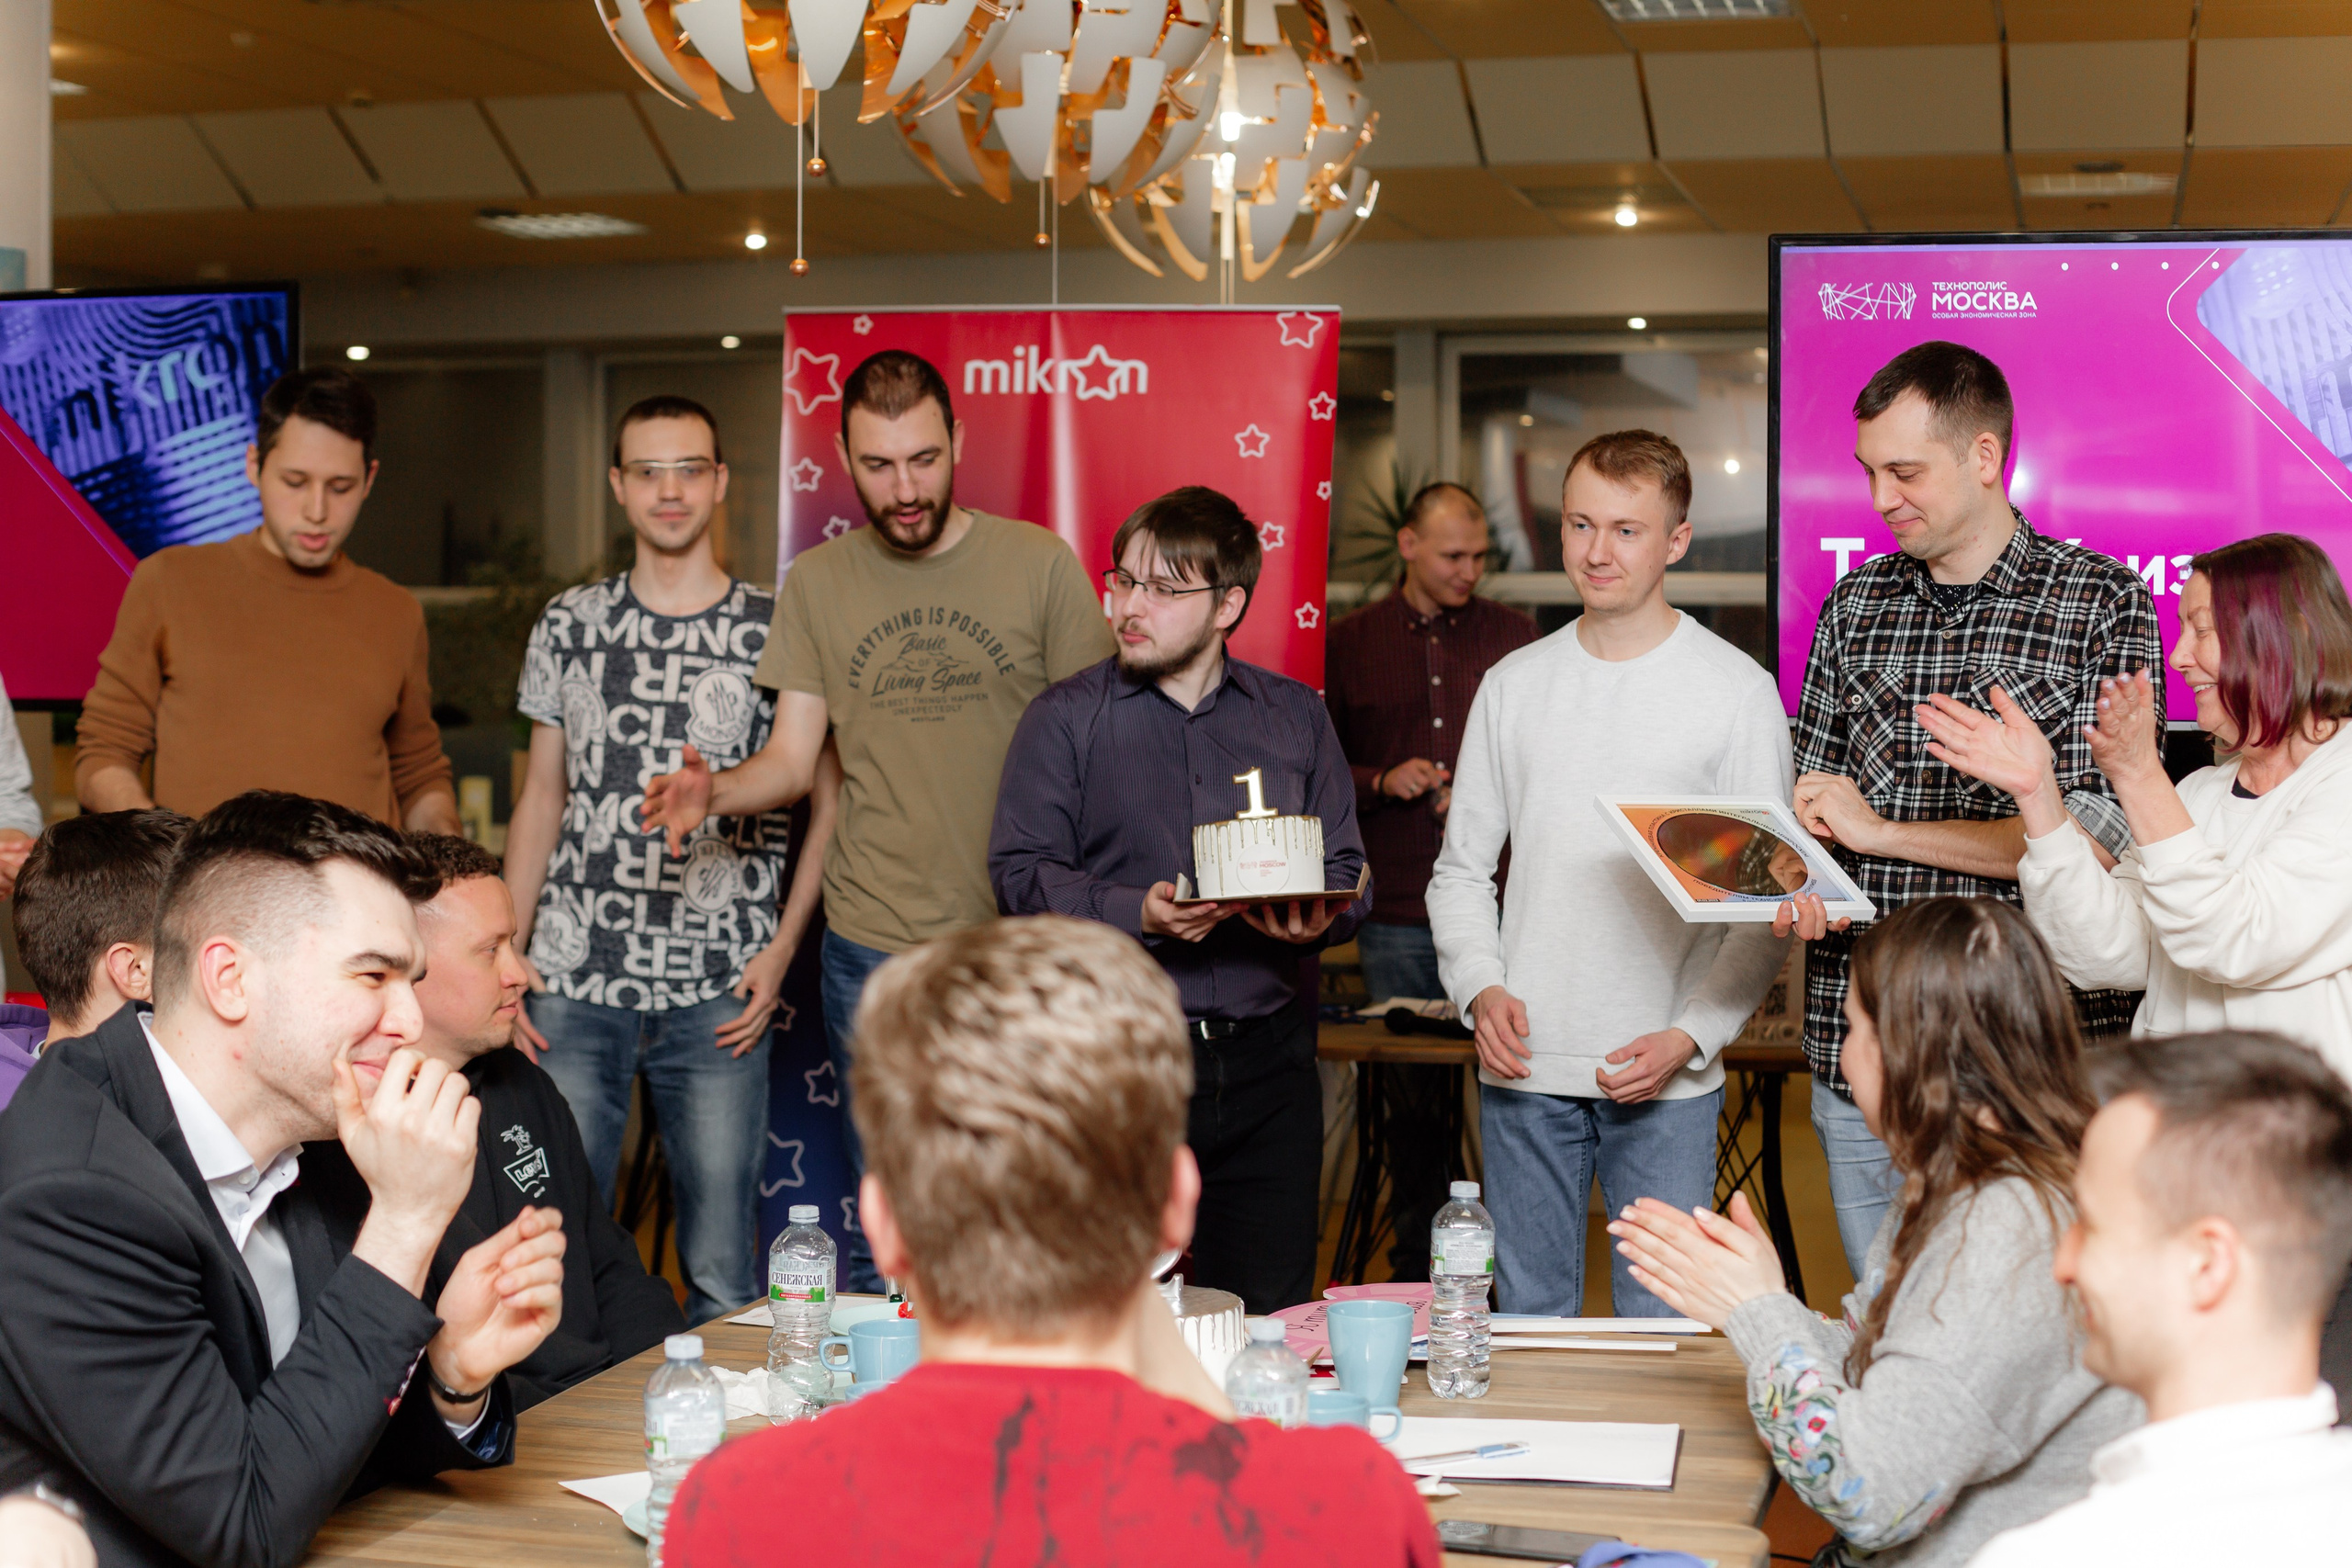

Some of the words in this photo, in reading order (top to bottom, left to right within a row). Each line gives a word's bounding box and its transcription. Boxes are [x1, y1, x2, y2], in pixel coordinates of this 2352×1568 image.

[1931, 281, 2007, 291] ТЕХНОПОЛИС
[1931, 291, 2038, 311] МОСКВА
[848, 607, 922, 689] EVERYTHING
[929, 606, 944, 625] IS
[948, 610, 1016, 676] POSSIBLE
[899, 632, 946, 655] Basic
[872, 671, 925, 697] Living
[931, 667, 982, 694] Space
[870, 701, 886, 710] THE
[888, 697, 909, 708] BEST
[913, 694, 947, 705] THINGS
[951, 693, 989, 703] HAPPEN
[893, 704, 963, 716] UNEXPECTEDLY
[1233, 766, 1278, 818] 1
[1718, 809, 1777, 831] ИНТЕГРАЛЬНЫХ
[1692, 879, 1749, 899] ПОБЕДИТЕЛЯМ
[772, 1272, 824, 1286] СЕНЕЖСКАЯ
